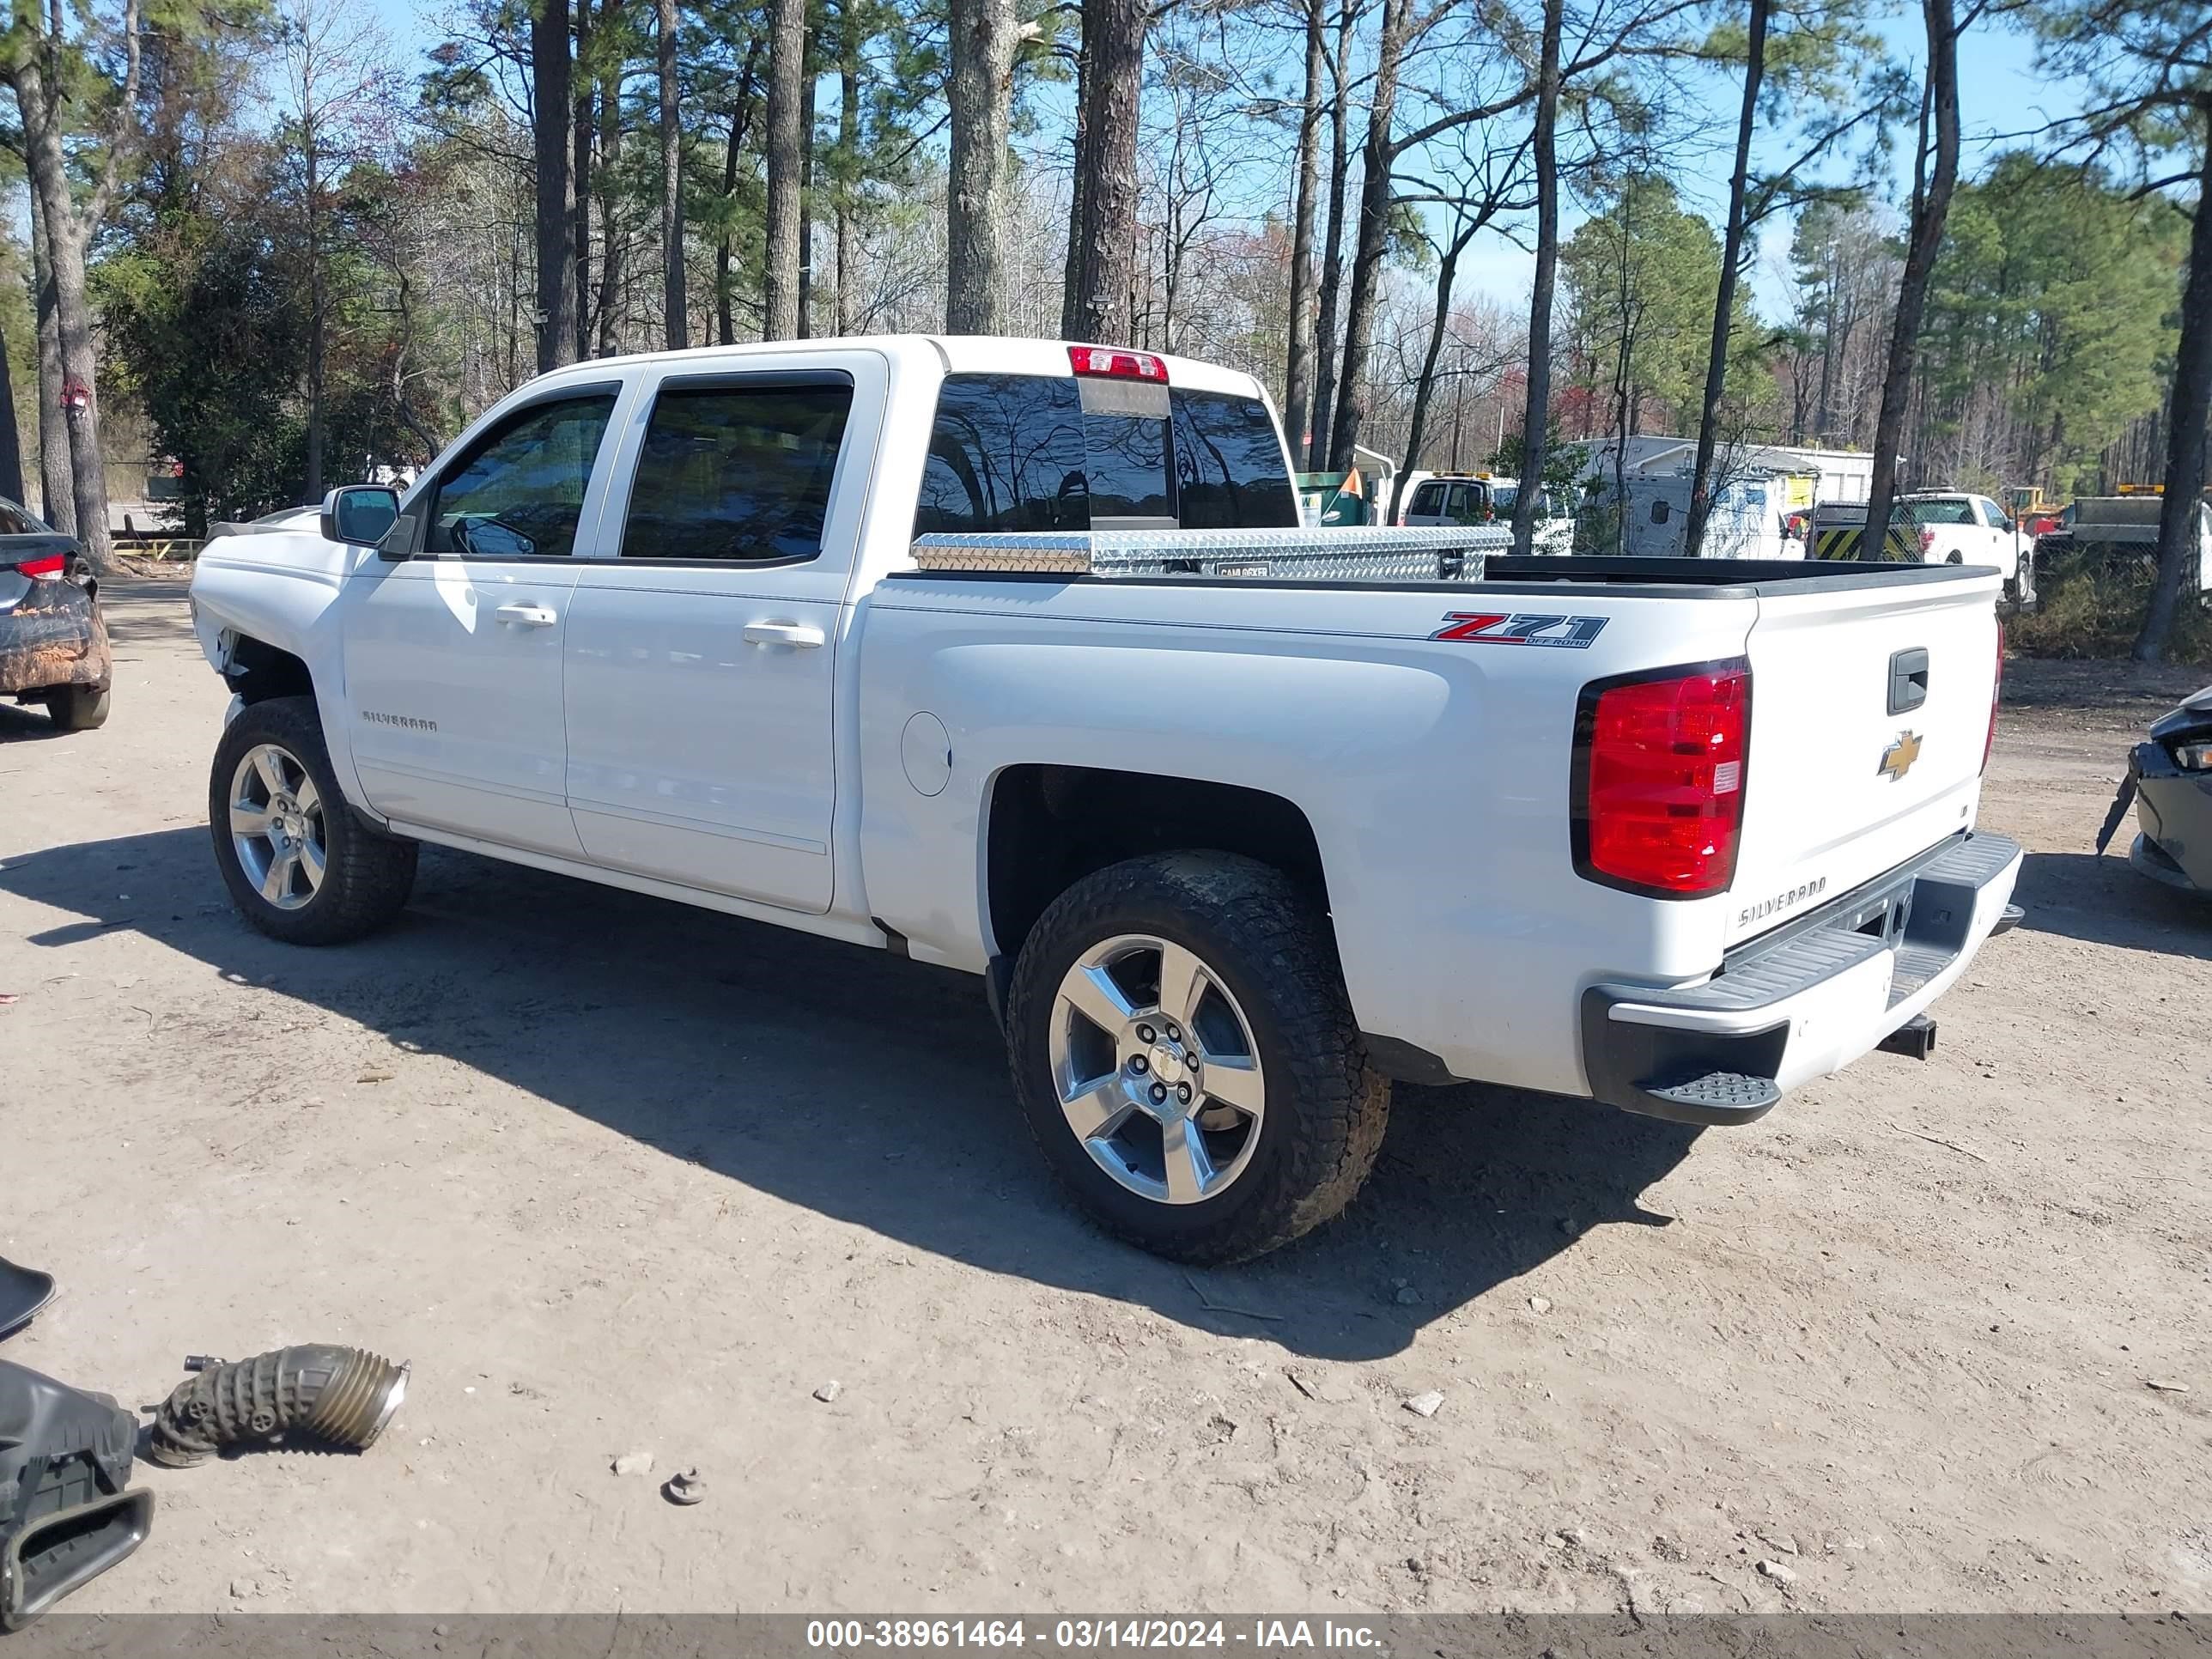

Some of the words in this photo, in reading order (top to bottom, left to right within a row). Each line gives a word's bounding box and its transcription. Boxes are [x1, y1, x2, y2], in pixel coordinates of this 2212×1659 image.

[1428, 611, 1610, 647] Z71
[362, 710, 438, 732] SILVERADO
[1738, 877, 1826, 927] SILVERADO
